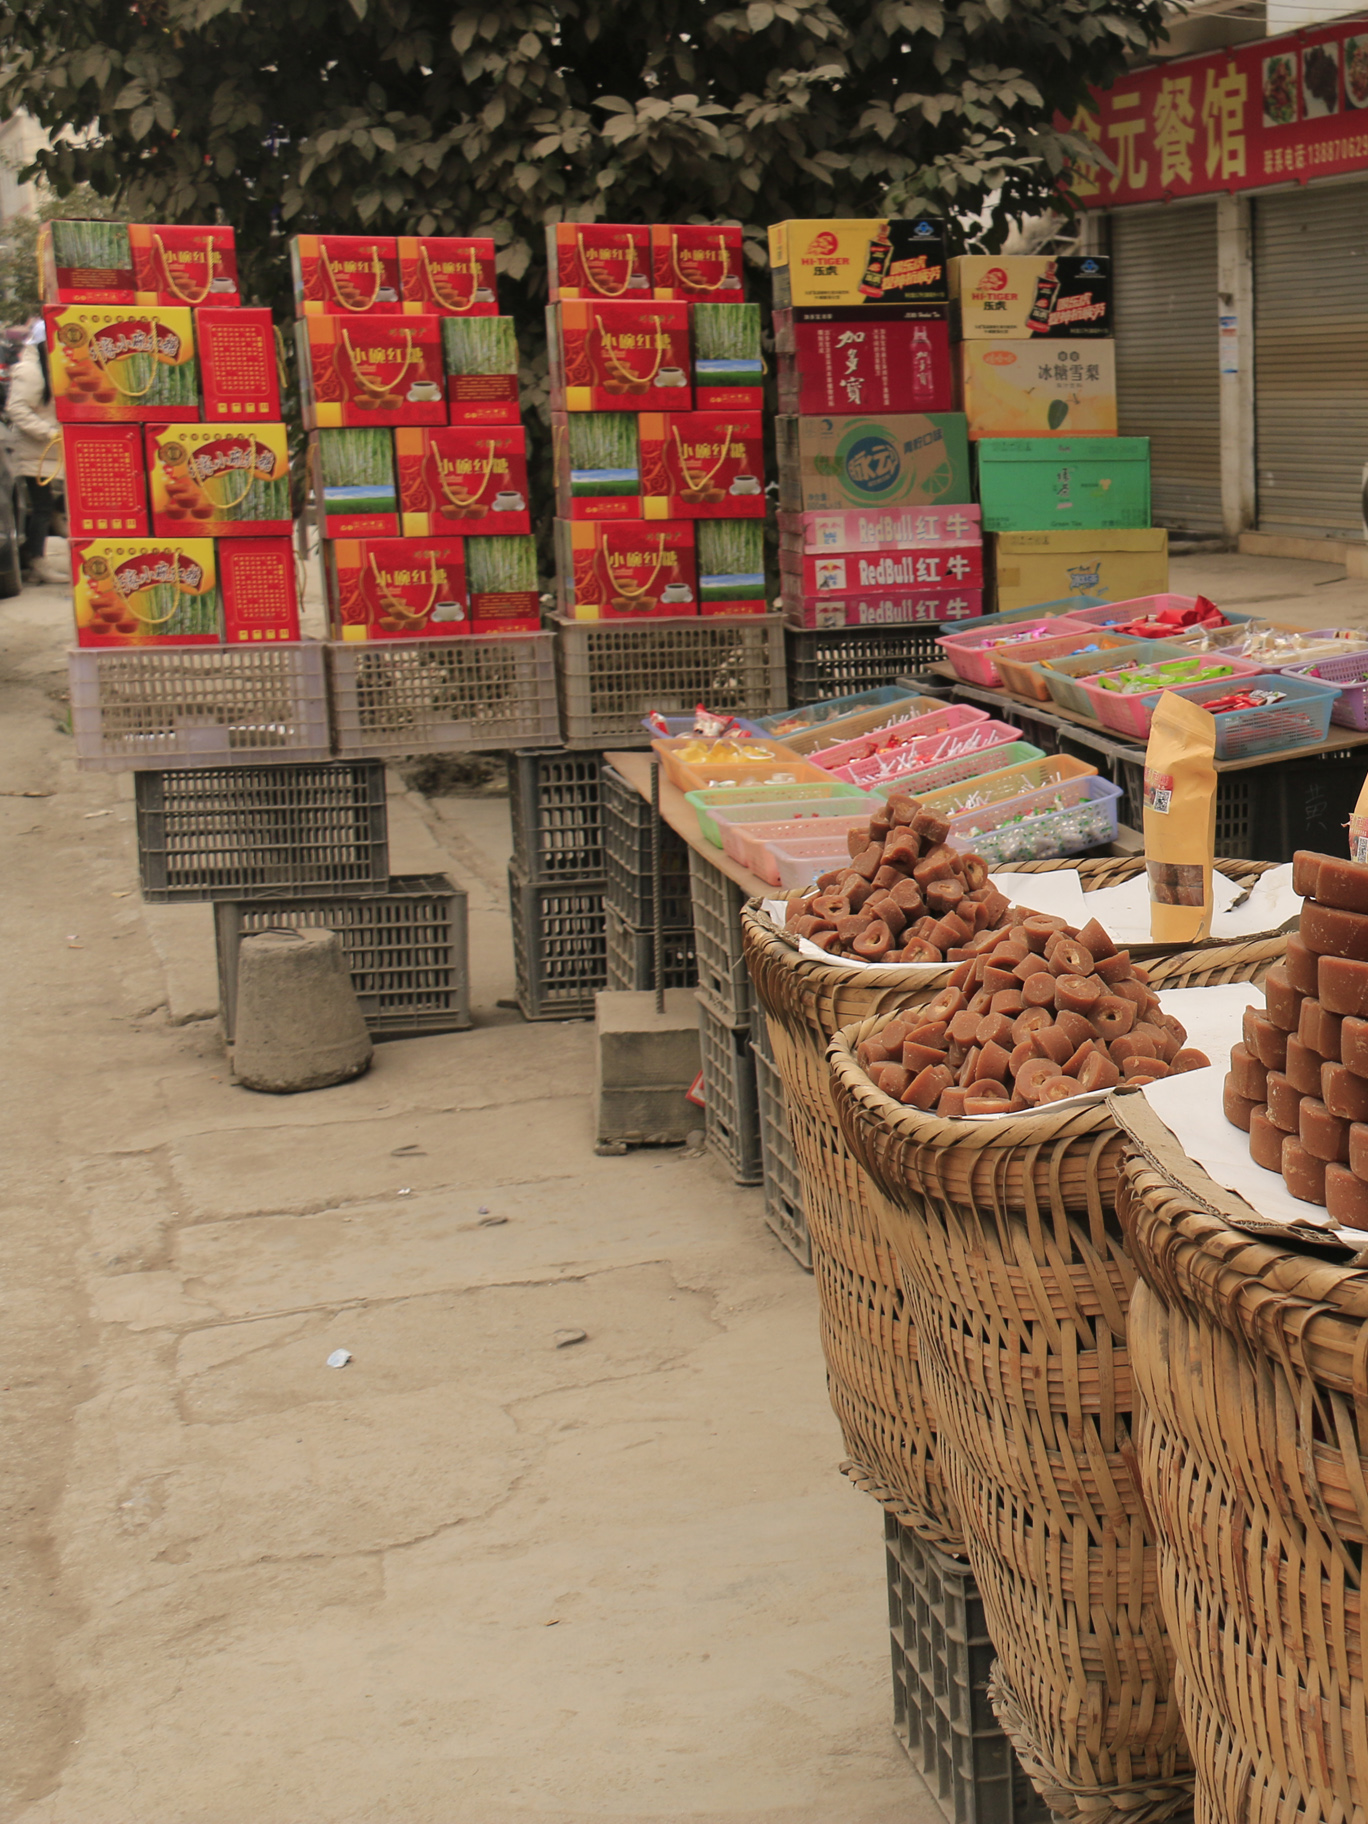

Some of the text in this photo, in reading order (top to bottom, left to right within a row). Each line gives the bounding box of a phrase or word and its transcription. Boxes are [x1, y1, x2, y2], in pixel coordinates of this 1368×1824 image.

[801, 257, 850, 266] HI-TIGER
[813, 266, 838, 276] 乐虎
[972, 292, 1018, 301] HI-TIGER
[983, 301, 1007, 311] 乐虎
[1038, 363, 1100, 382] 冰糖雪梨
[859, 515, 912, 543] RedBull
[915, 513, 970, 541] 红牛
[859, 556, 914, 586] RedBull
[916, 555, 971, 583] 红牛
[859, 599, 912, 624] RedBull
[915, 597, 970, 621] 红牛
